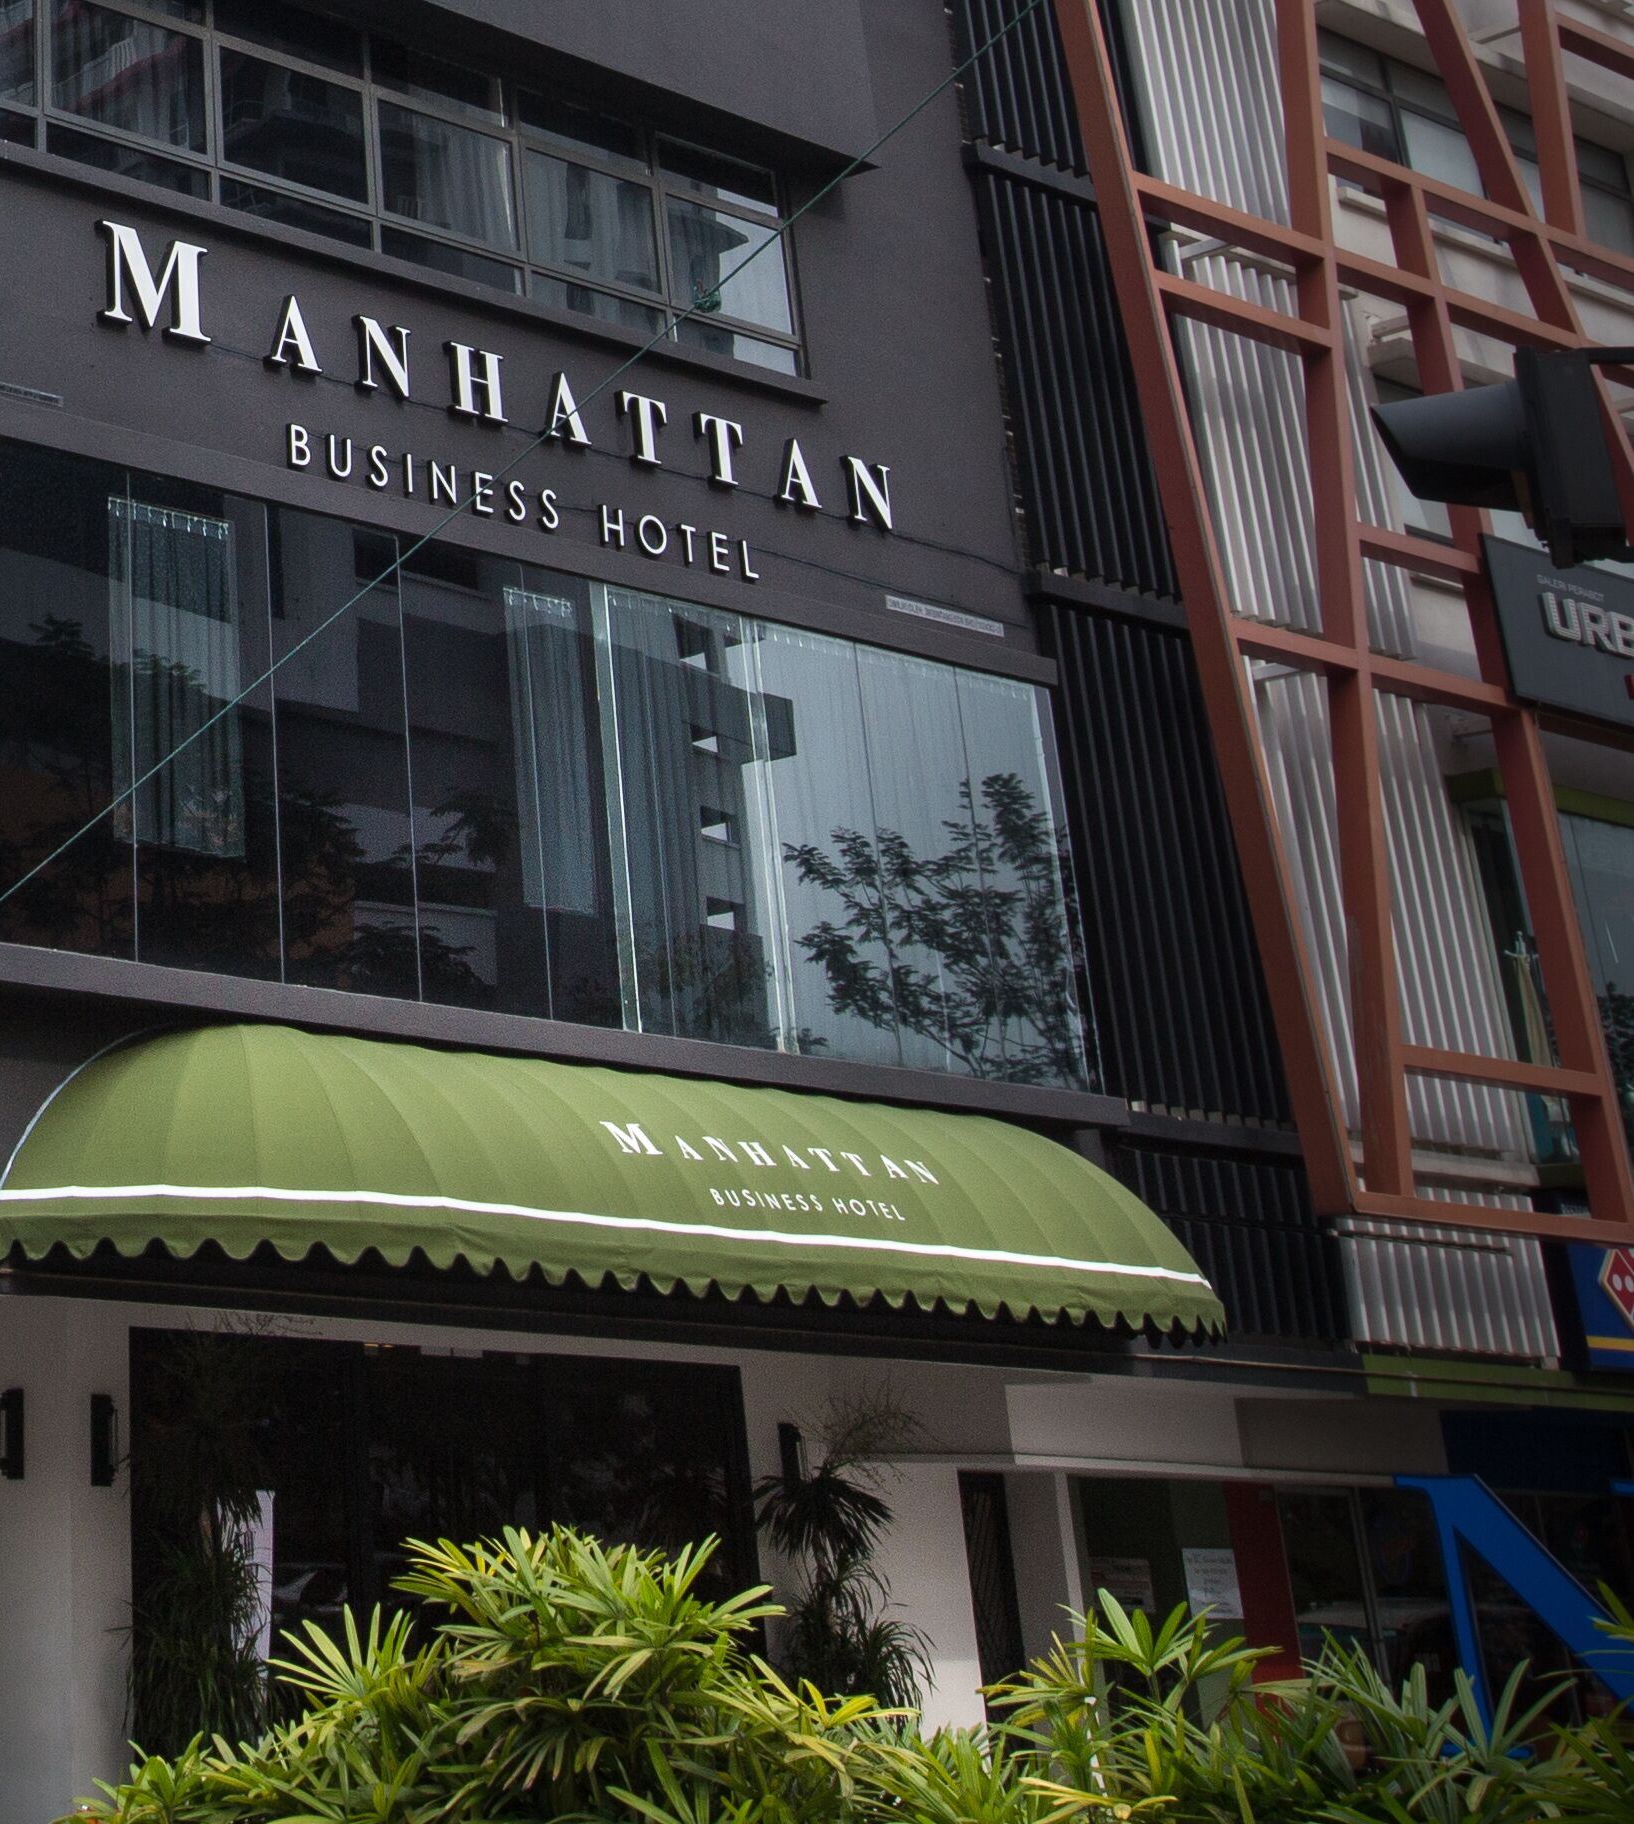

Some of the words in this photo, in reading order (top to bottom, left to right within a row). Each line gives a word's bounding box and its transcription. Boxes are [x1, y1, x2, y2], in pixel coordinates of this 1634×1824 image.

[100, 219, 894, 533] MANHATTAN
[287, 422, 560, 531] BUSINESS
[599, 504, 760, 582] HOTEL
[599, 1120, 940, 1185] MANHATTAN
[709, 1188, 824, 1213] BUSINESS
[832, 1197, 907, 1222] HOTEL
